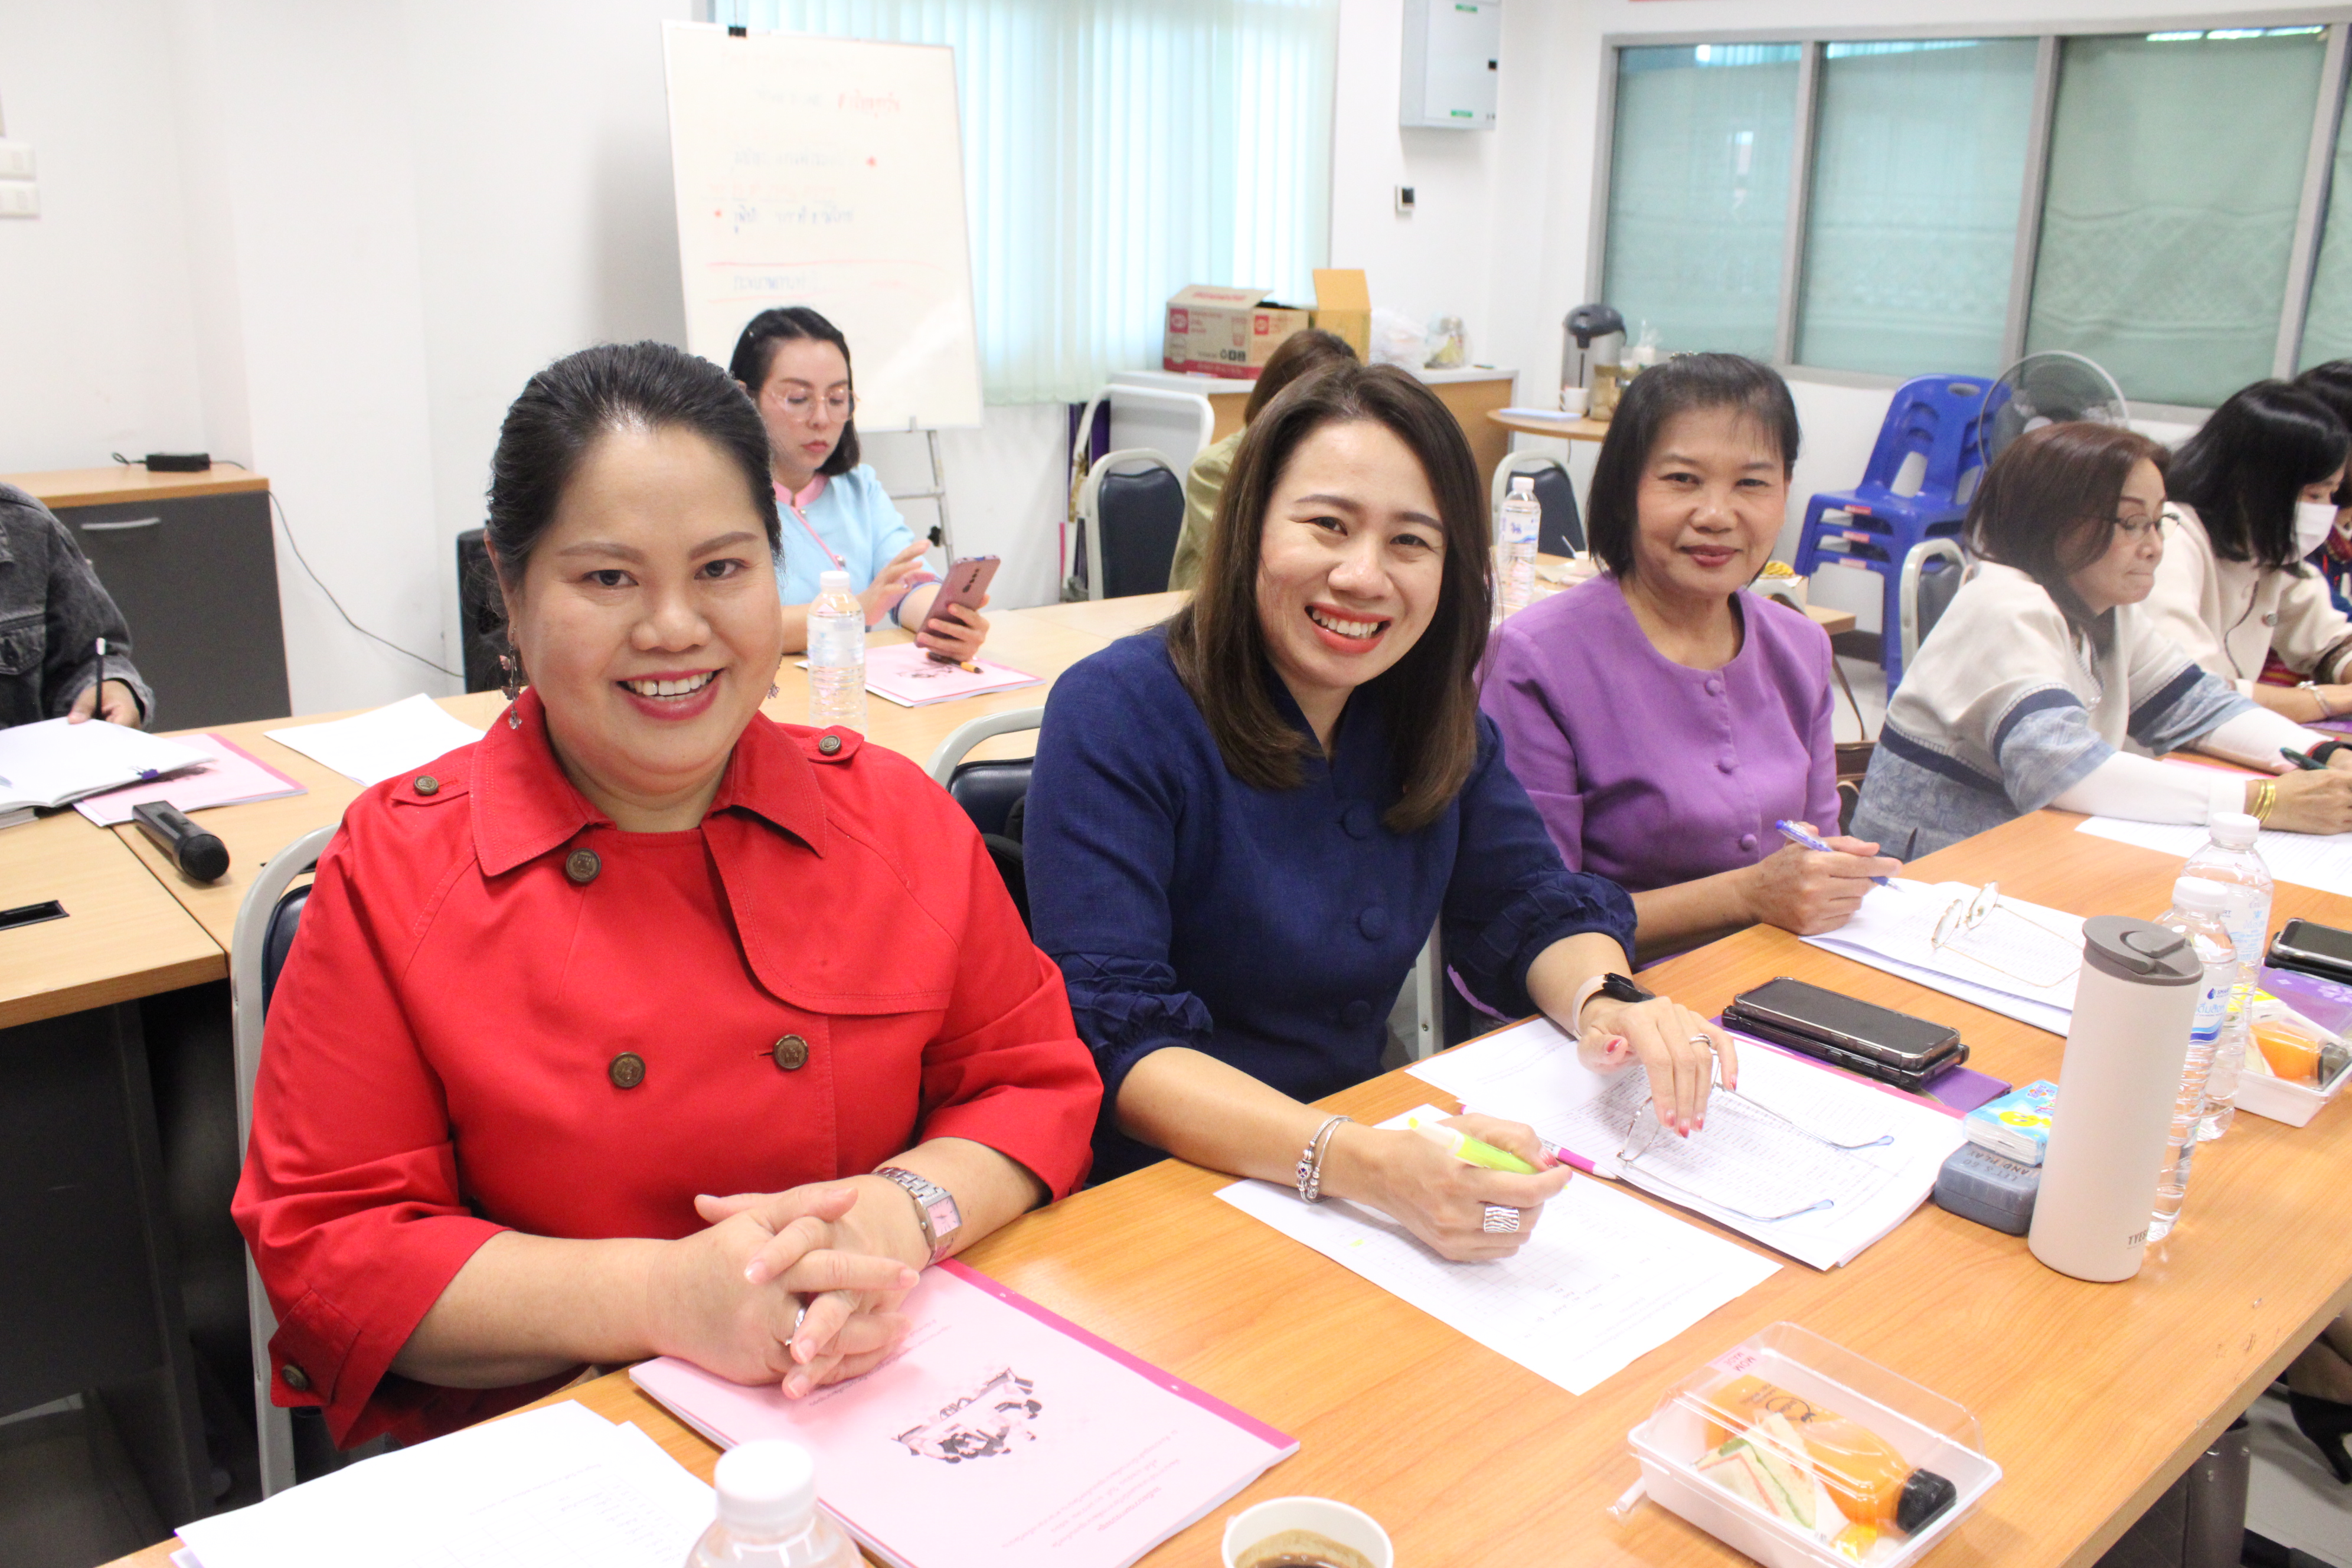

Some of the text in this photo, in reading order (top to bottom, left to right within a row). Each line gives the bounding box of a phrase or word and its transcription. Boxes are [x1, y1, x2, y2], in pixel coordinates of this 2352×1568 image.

[1963, 1159, 1979, 1168] GO
[1967, 1151, 2029, 1174] AND PLAY
[2128, 1229, 2148, 1245] TYES
[1733, 1356, 1757, 1372] MOM
